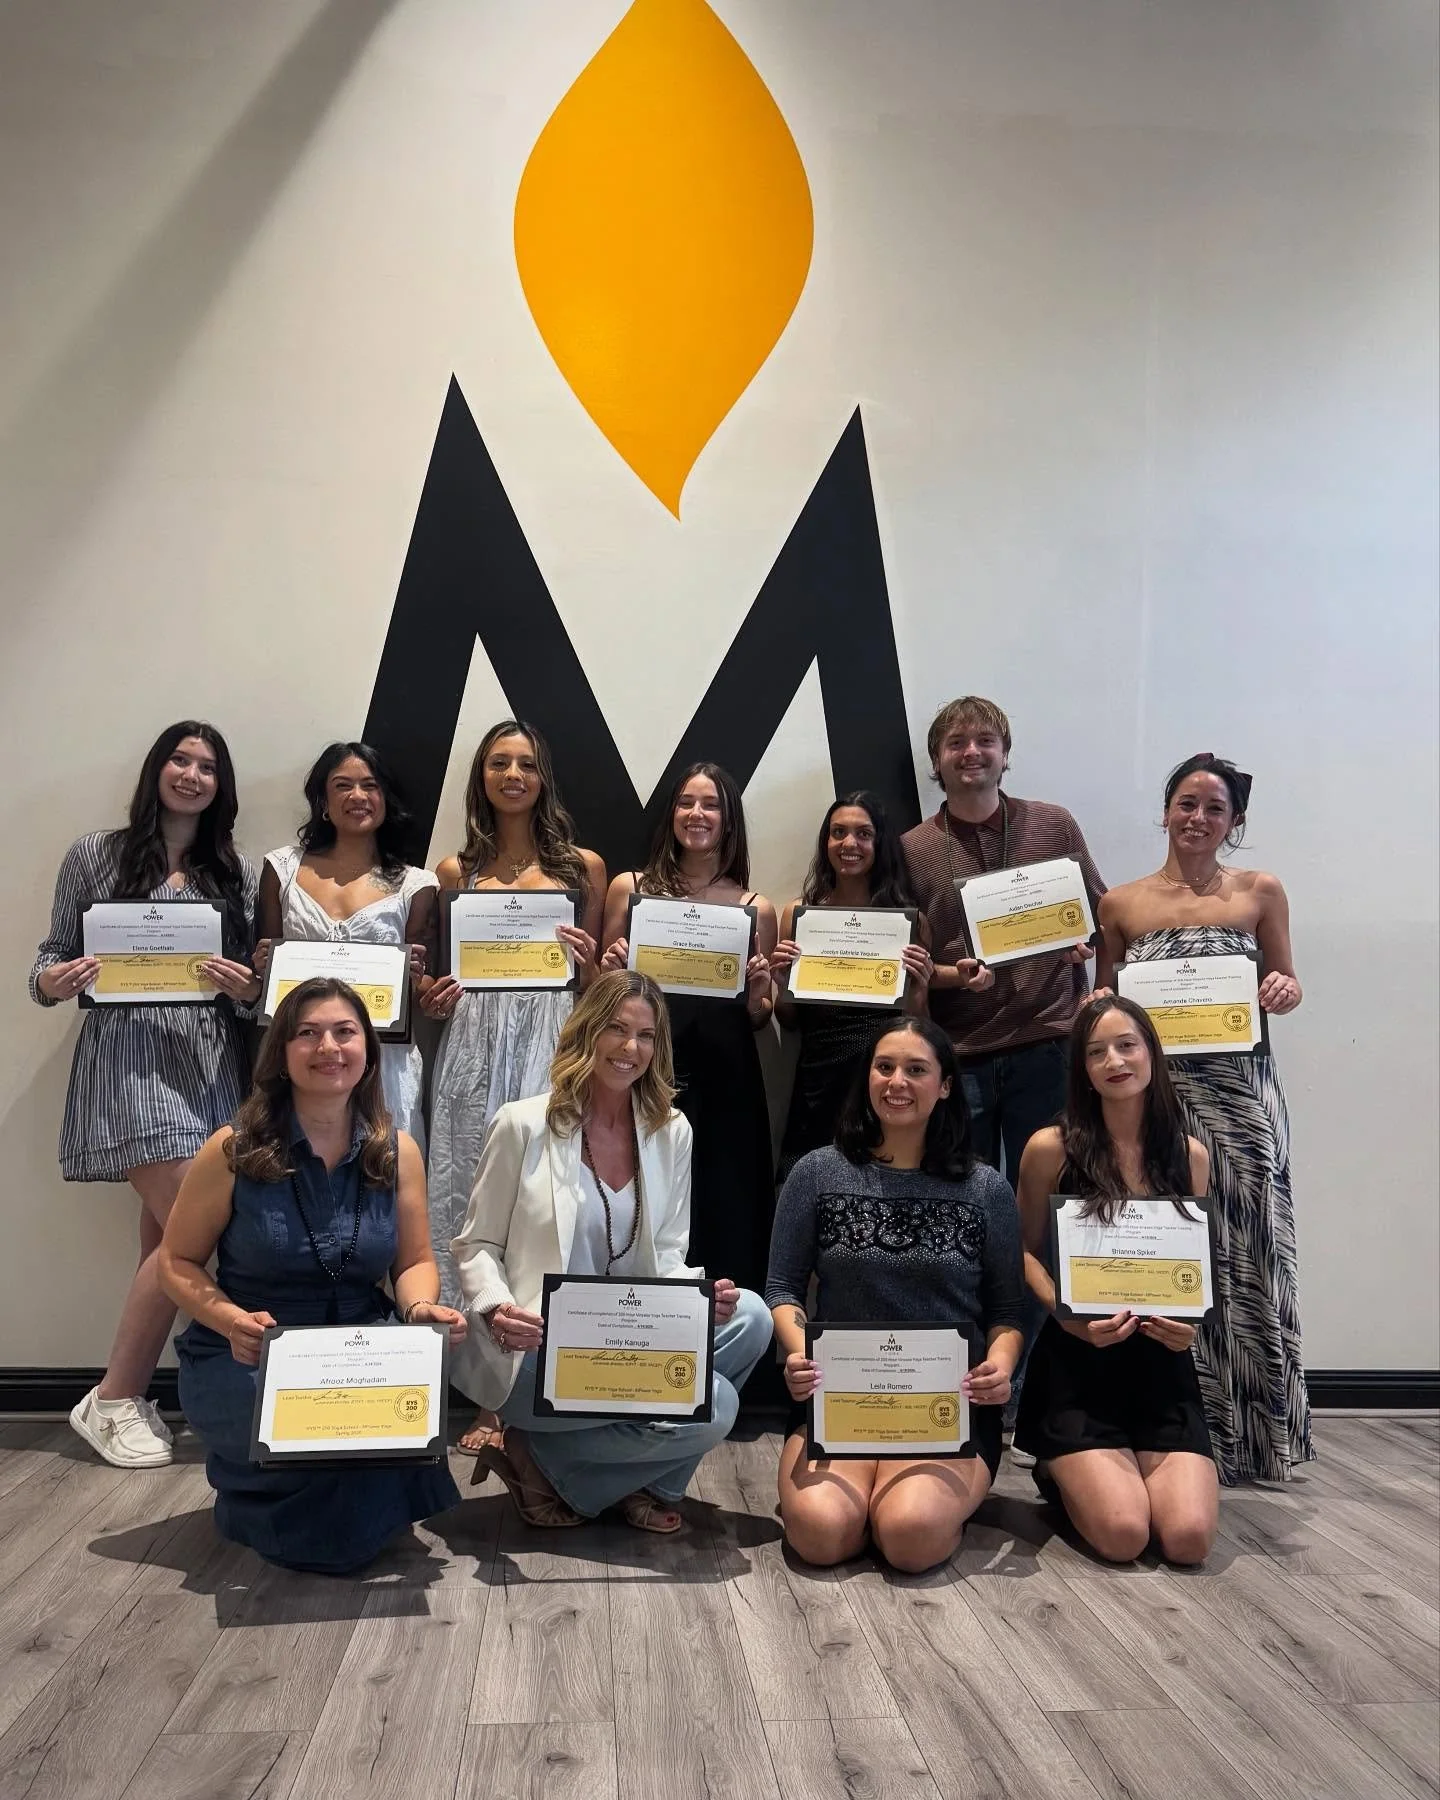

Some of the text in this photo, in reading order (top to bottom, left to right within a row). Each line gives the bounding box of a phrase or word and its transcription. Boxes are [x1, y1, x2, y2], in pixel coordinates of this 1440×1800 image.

[618, 1299, 642, 1307] POWER
[605, 1338, 650, 1348] Emily Kanuga
[879, 1344, 903, 1352] POWER
[320, 1377, 387, 1385] Afrooz Moghadam
